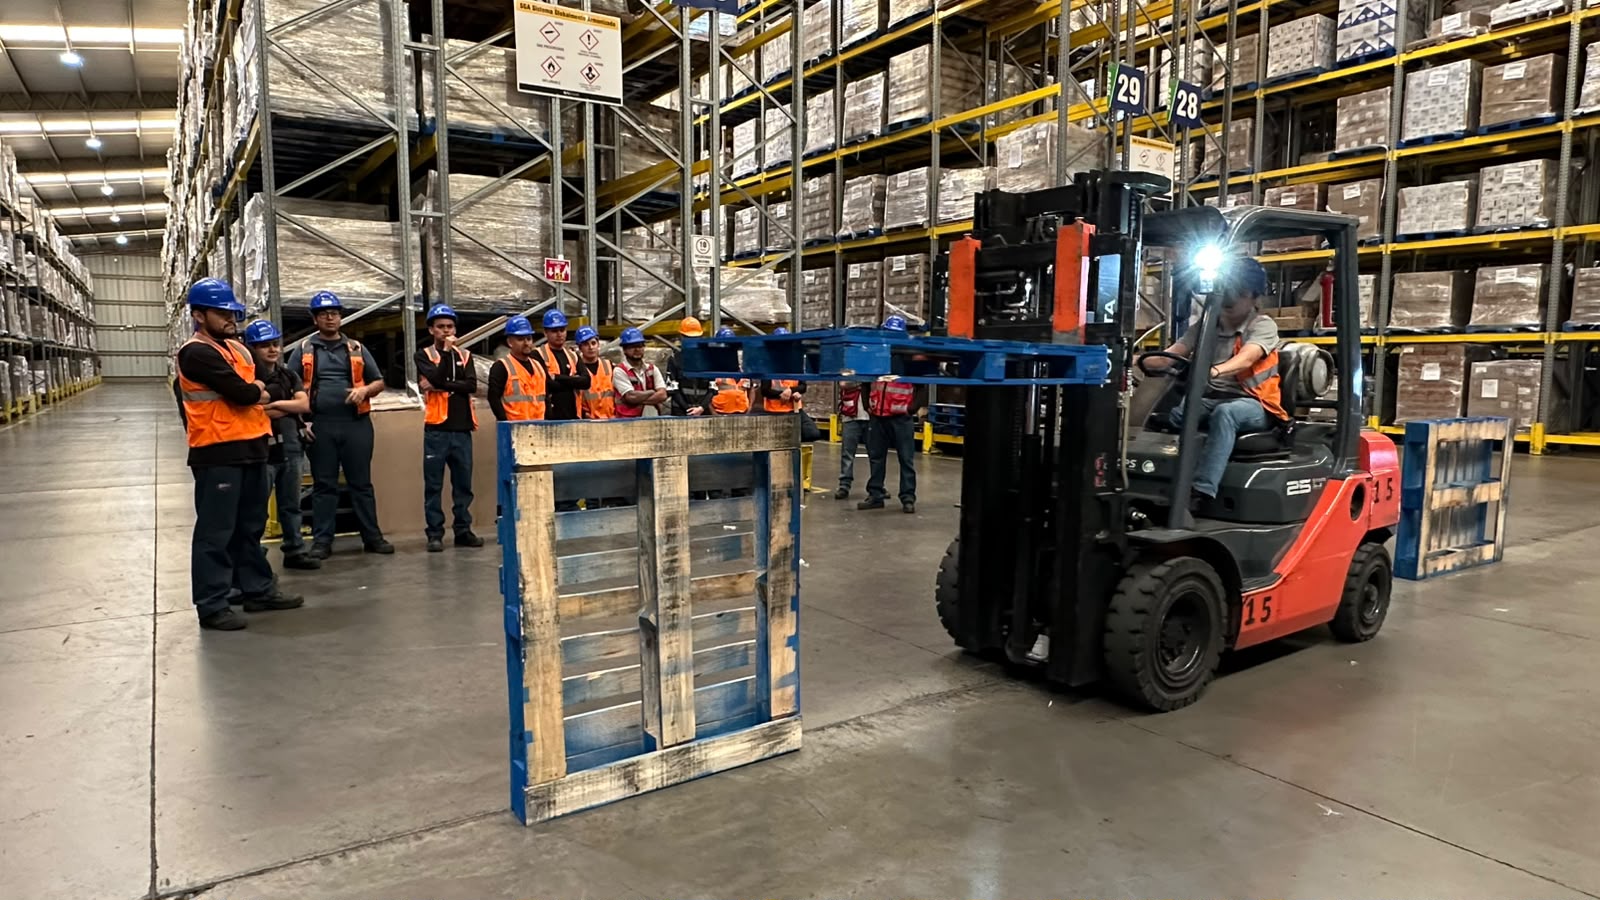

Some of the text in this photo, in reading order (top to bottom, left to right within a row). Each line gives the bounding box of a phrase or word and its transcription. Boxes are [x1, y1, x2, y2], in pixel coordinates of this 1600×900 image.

[1117, 74, 1141, 105] 29
[1176, 89, 1198, 120] 28
[1286, 479, 1312, 496] 25
[1373, 477, 1393, 503] 15
[1244, 596, 1272, 626] 15
